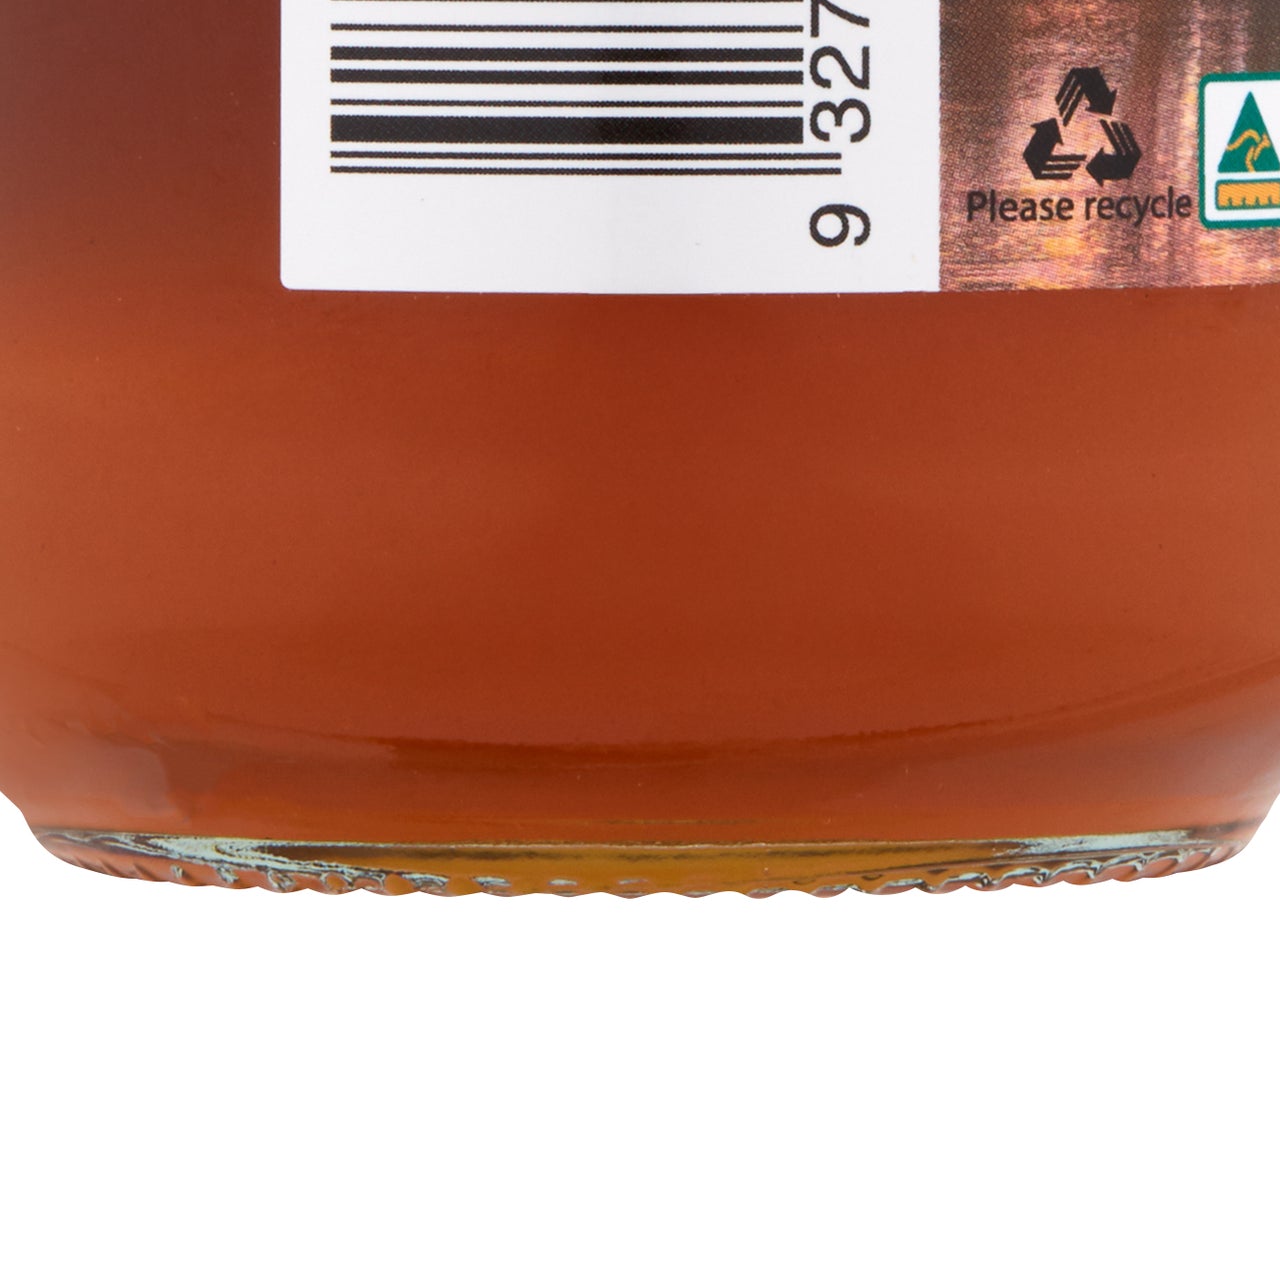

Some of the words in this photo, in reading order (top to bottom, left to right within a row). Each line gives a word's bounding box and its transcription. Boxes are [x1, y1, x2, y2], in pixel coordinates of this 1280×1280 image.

[809, 204, 871, 248] 9
[963, 187, 1077, 225] Please
[1082, 183, 1195, 228] recycle
